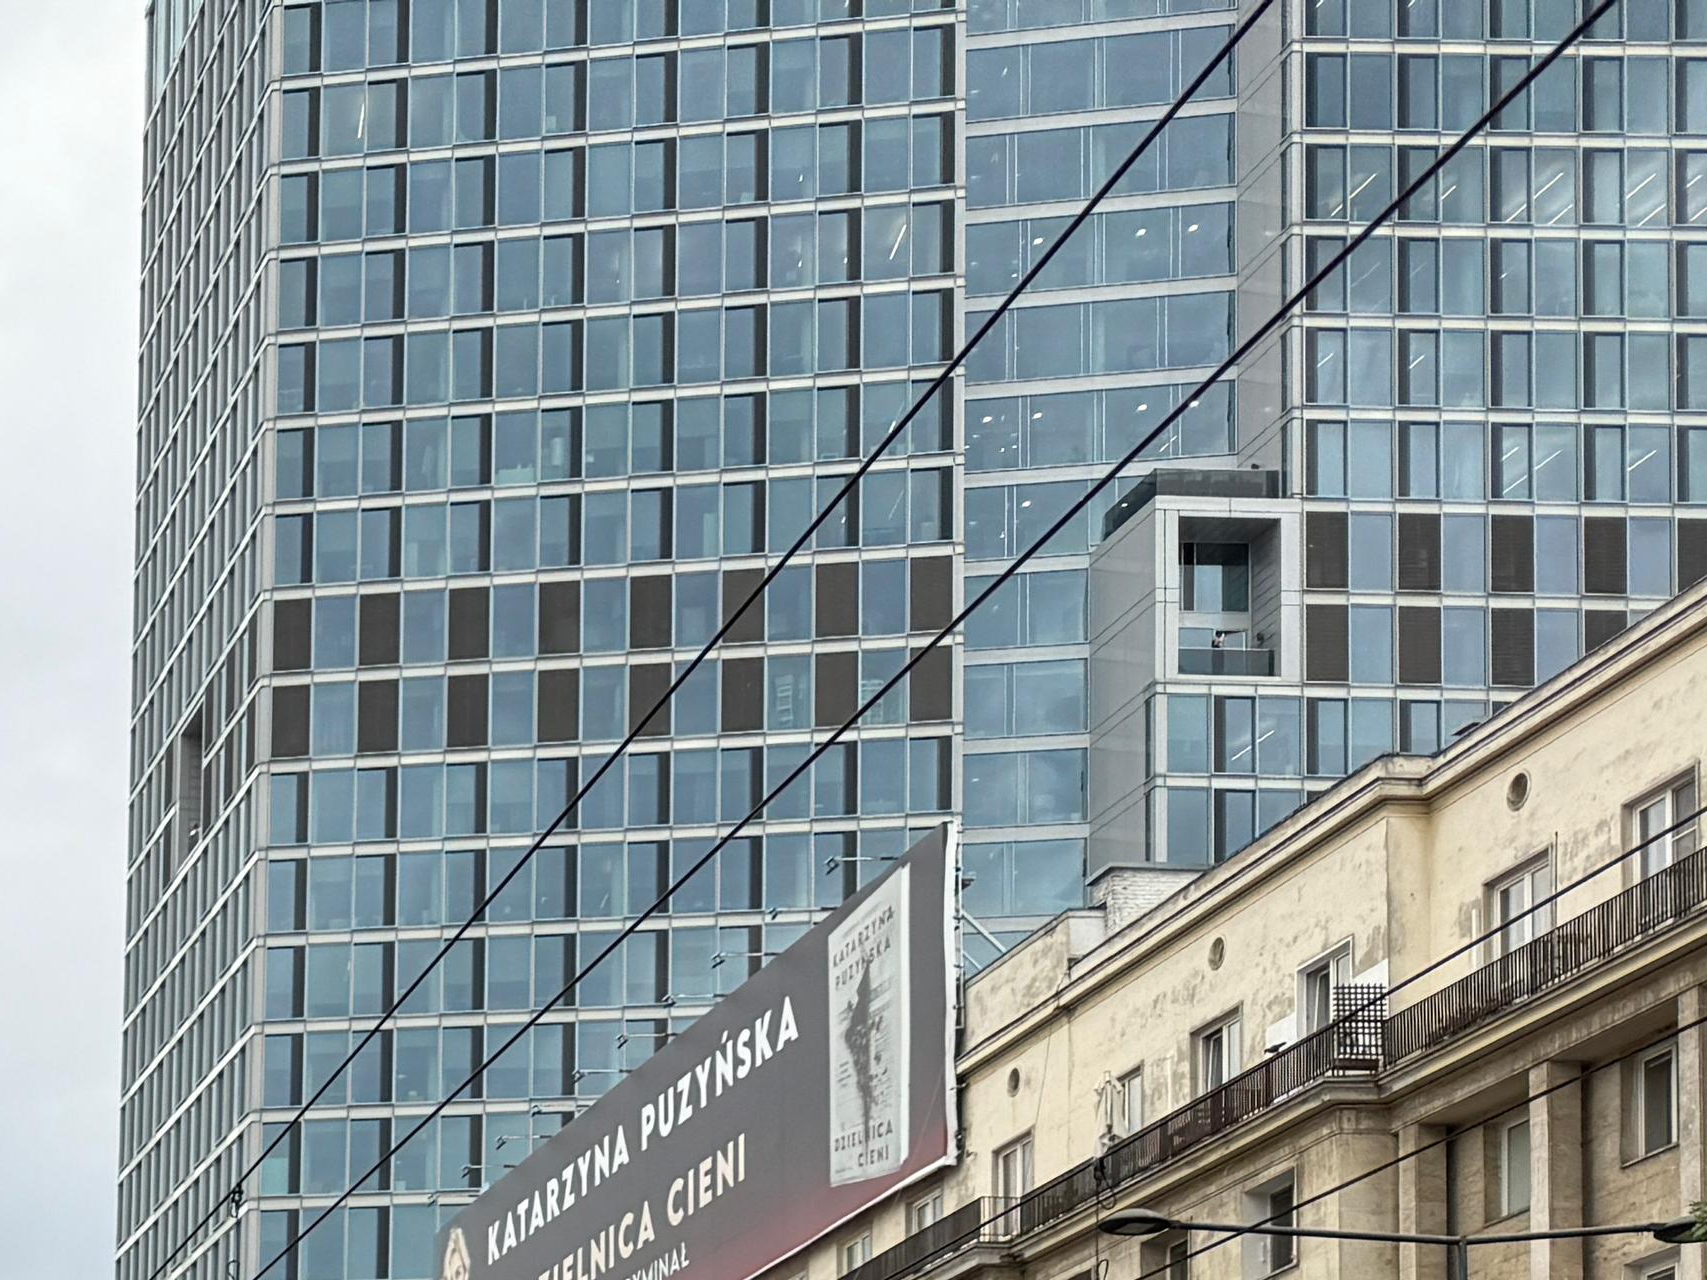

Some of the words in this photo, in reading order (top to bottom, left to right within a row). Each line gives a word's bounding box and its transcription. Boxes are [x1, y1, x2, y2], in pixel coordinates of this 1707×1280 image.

[487, 1126, 631, 1266] KATARZYNA
[640, 996, 800, 1151] PUZYŃSKA
[666, 1133, 748, 1229] CIENI
